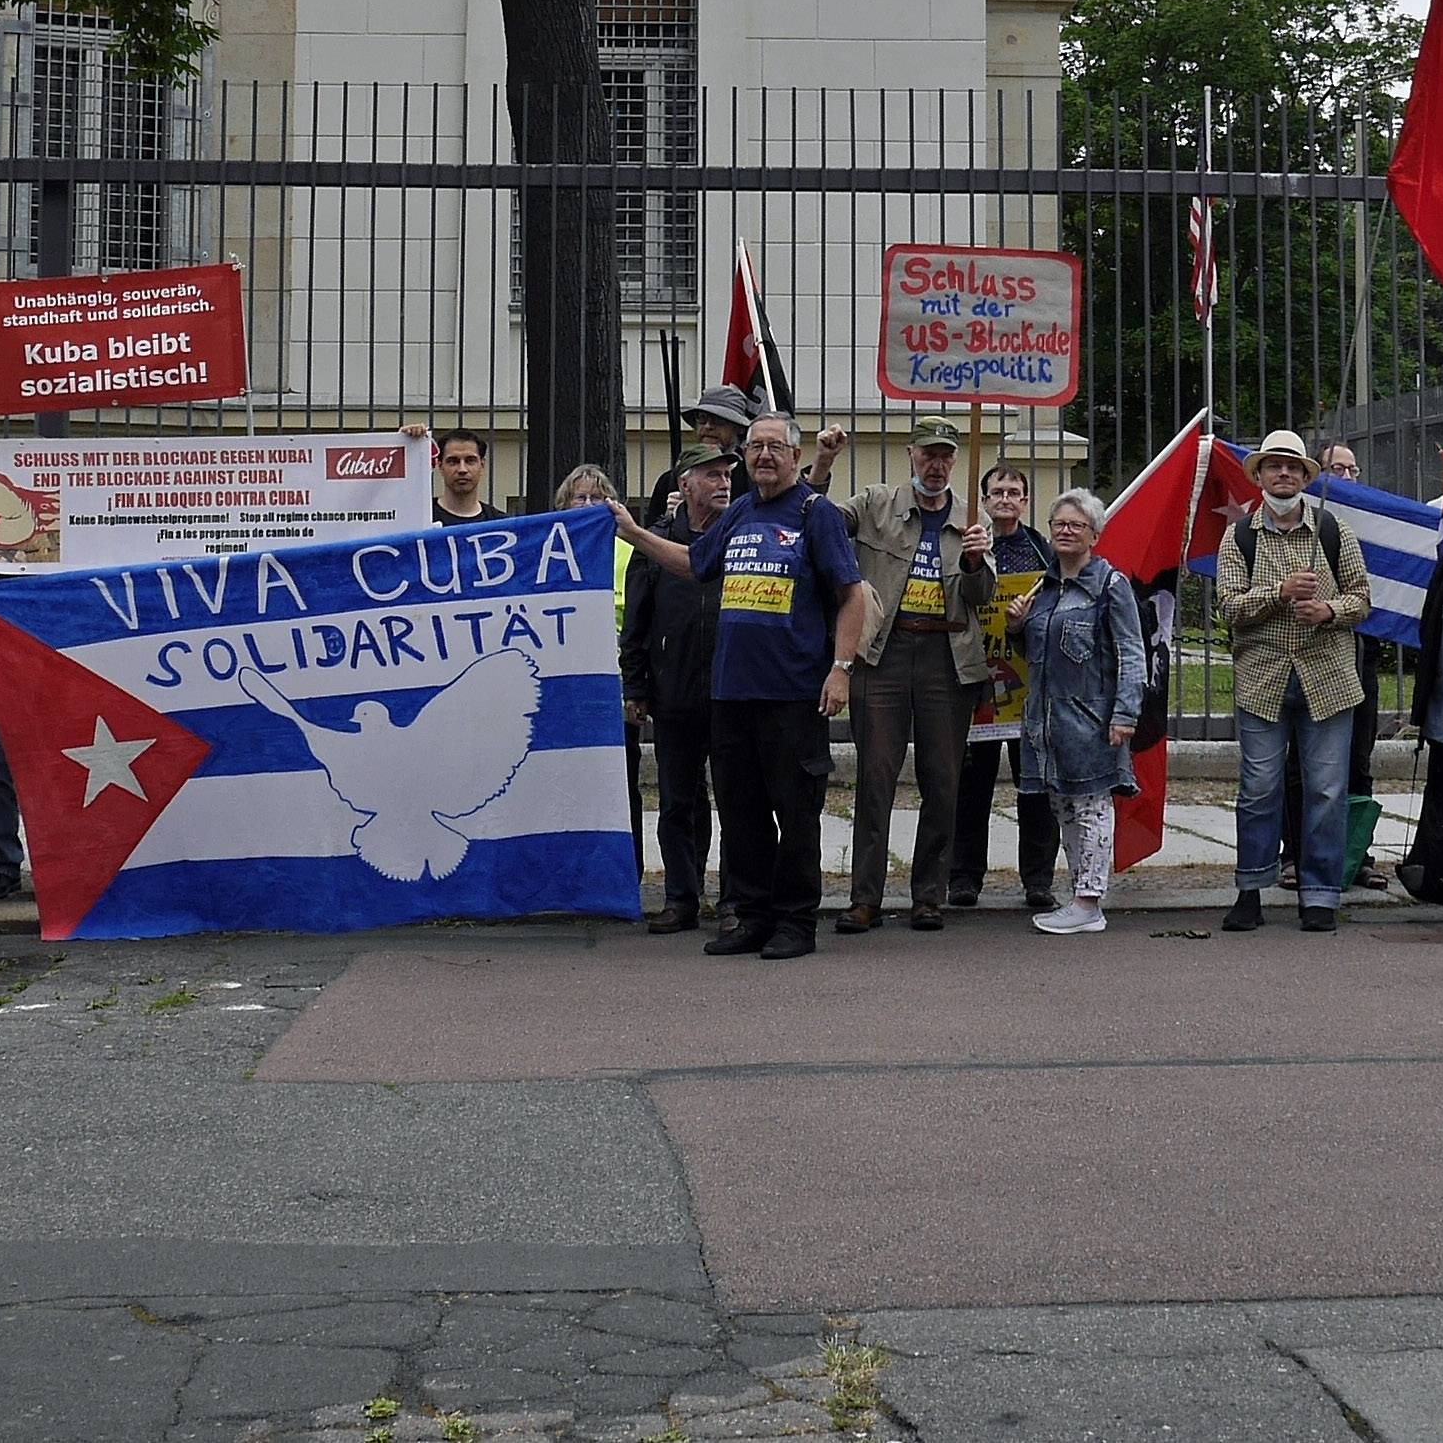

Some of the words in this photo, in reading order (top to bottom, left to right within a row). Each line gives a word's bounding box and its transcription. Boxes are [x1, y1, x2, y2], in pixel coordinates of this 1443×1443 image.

[900, 257, 1036, 301] Schluss
[13, 290, 117, 311] Unabhängig,
[122, 283, 202, 302] souverän,
[920, 294, 960, 316] mit
[972, 298, 1016, 317] der
[3, 308, 83, 327] standhaft
[87, 306, 118, 322] und
[122, 299, 215, 319] solidarisch.
[24, 340, 98, 365] Kuba
[108, 332, 191, 359] bleibt
[21, 362, 208, 397] sozialistisch!
[14, 452, 79, 467] SCHLUSS
[83, 452, 109, 467] MIT
[112, 451, 140, 466] DER
[143, 450, 217, 466] BLOCKADE
[220, 449, 265, 464] GEGEN
[268, 449, 313, 464] KUBA!
[33, 472, 60, 487] END
[67, 472, 93, 487] THE
[97, 470, 170, 486] BLOCKADE
[173, 470, 235, 485] AGAINST
[238, 469, 283, 484] CUBA!
[115, 493, 135, 508] FIN
[138, 492, 153, 507] AL
[155, 491, 213, 507] BLOQUEO
[215, 491, 266, 506] CONTRA
[269, 490, 310, 505] CUBA!
[69, 515, 96, 525] Keine
[239, 512, 261, 524] Stop
[262, 511, 275, 522] all
[276, 511, 309, 523] regime
[347, 509, 396, 522] programs!
[175, 530, 181, 539] a
[183, 529, 198, 539] los
[199, 528, 250, 540] programas
[252, 528, 264, 538] de
[266, 527, 300, 537] cambio
[302, 527, 314, 537] de
[90, 554, 307, 630] VIVA
[354, 522, 582, 602] CUBA
[146, 605, 577, 687] SOLIDARITÄT
